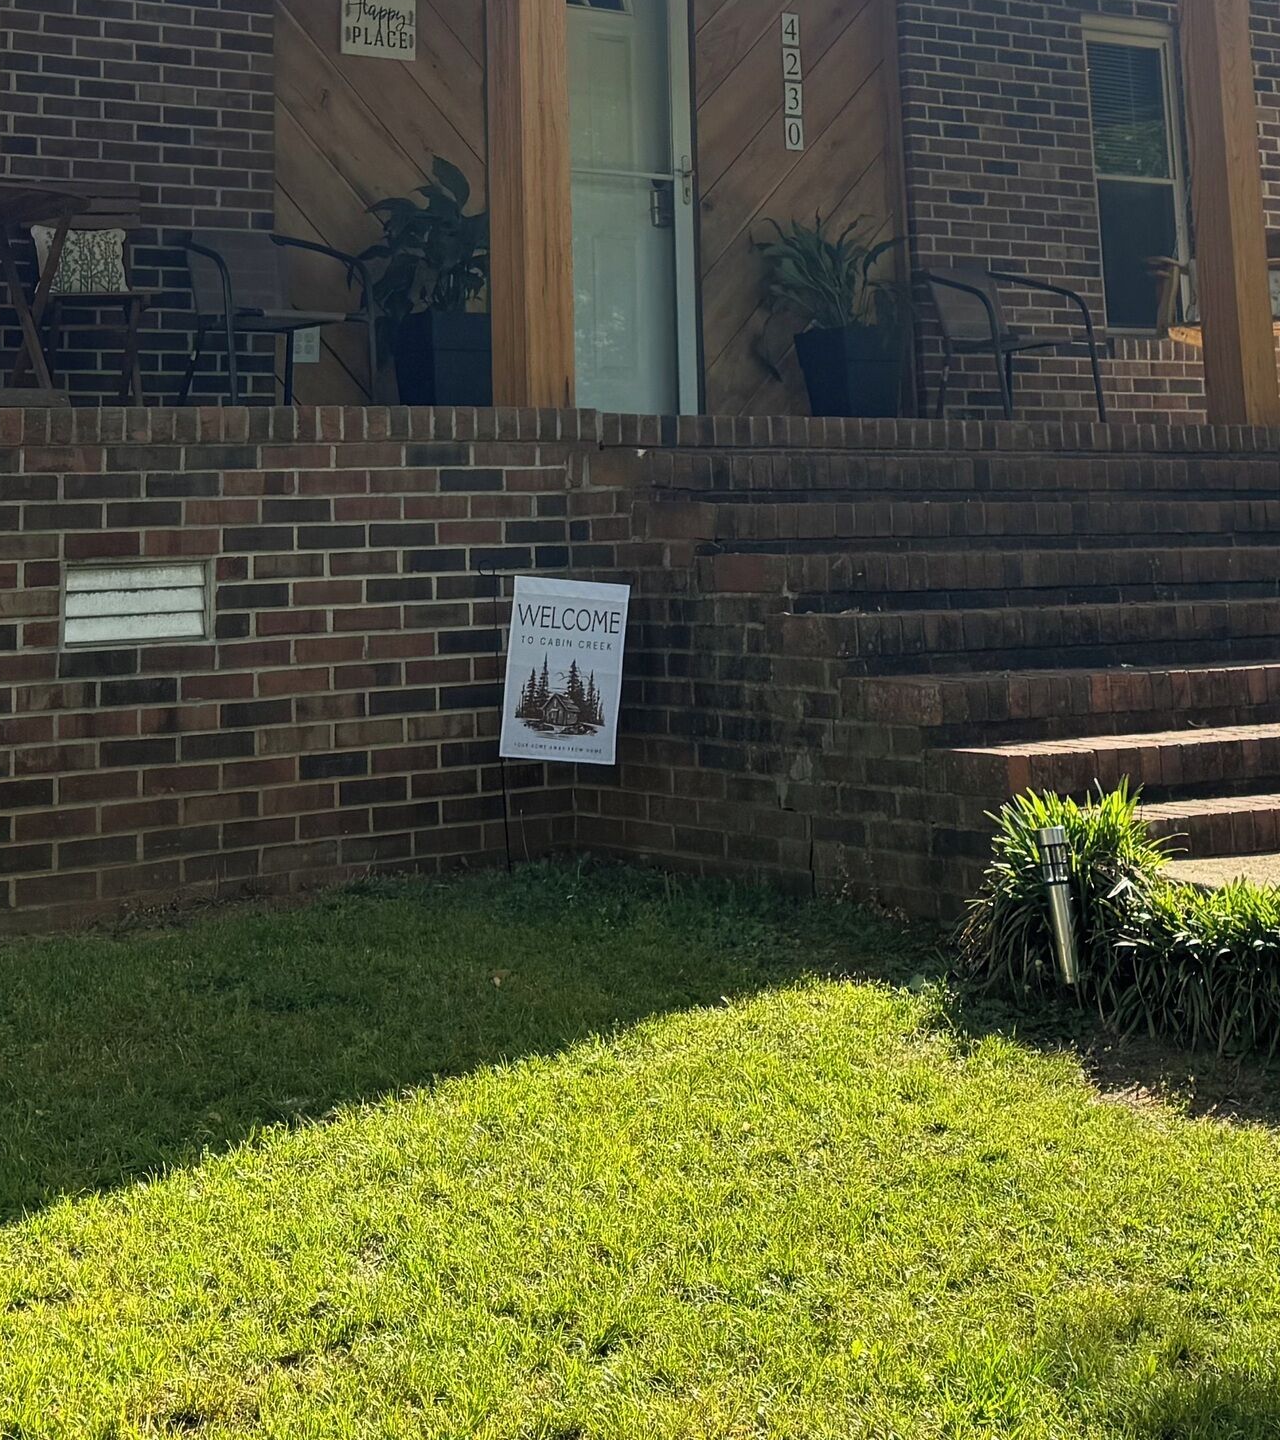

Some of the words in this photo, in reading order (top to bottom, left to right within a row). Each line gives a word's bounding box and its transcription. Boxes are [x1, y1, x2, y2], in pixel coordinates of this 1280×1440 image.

[352, 26, 408, 49] PLACE
[518, 603, 621, 634] WELCOME
[521, 636, 534, 645] TO
[540, 637, 573, 648] CABIN
[578, 640, 613, 651] CREEK
